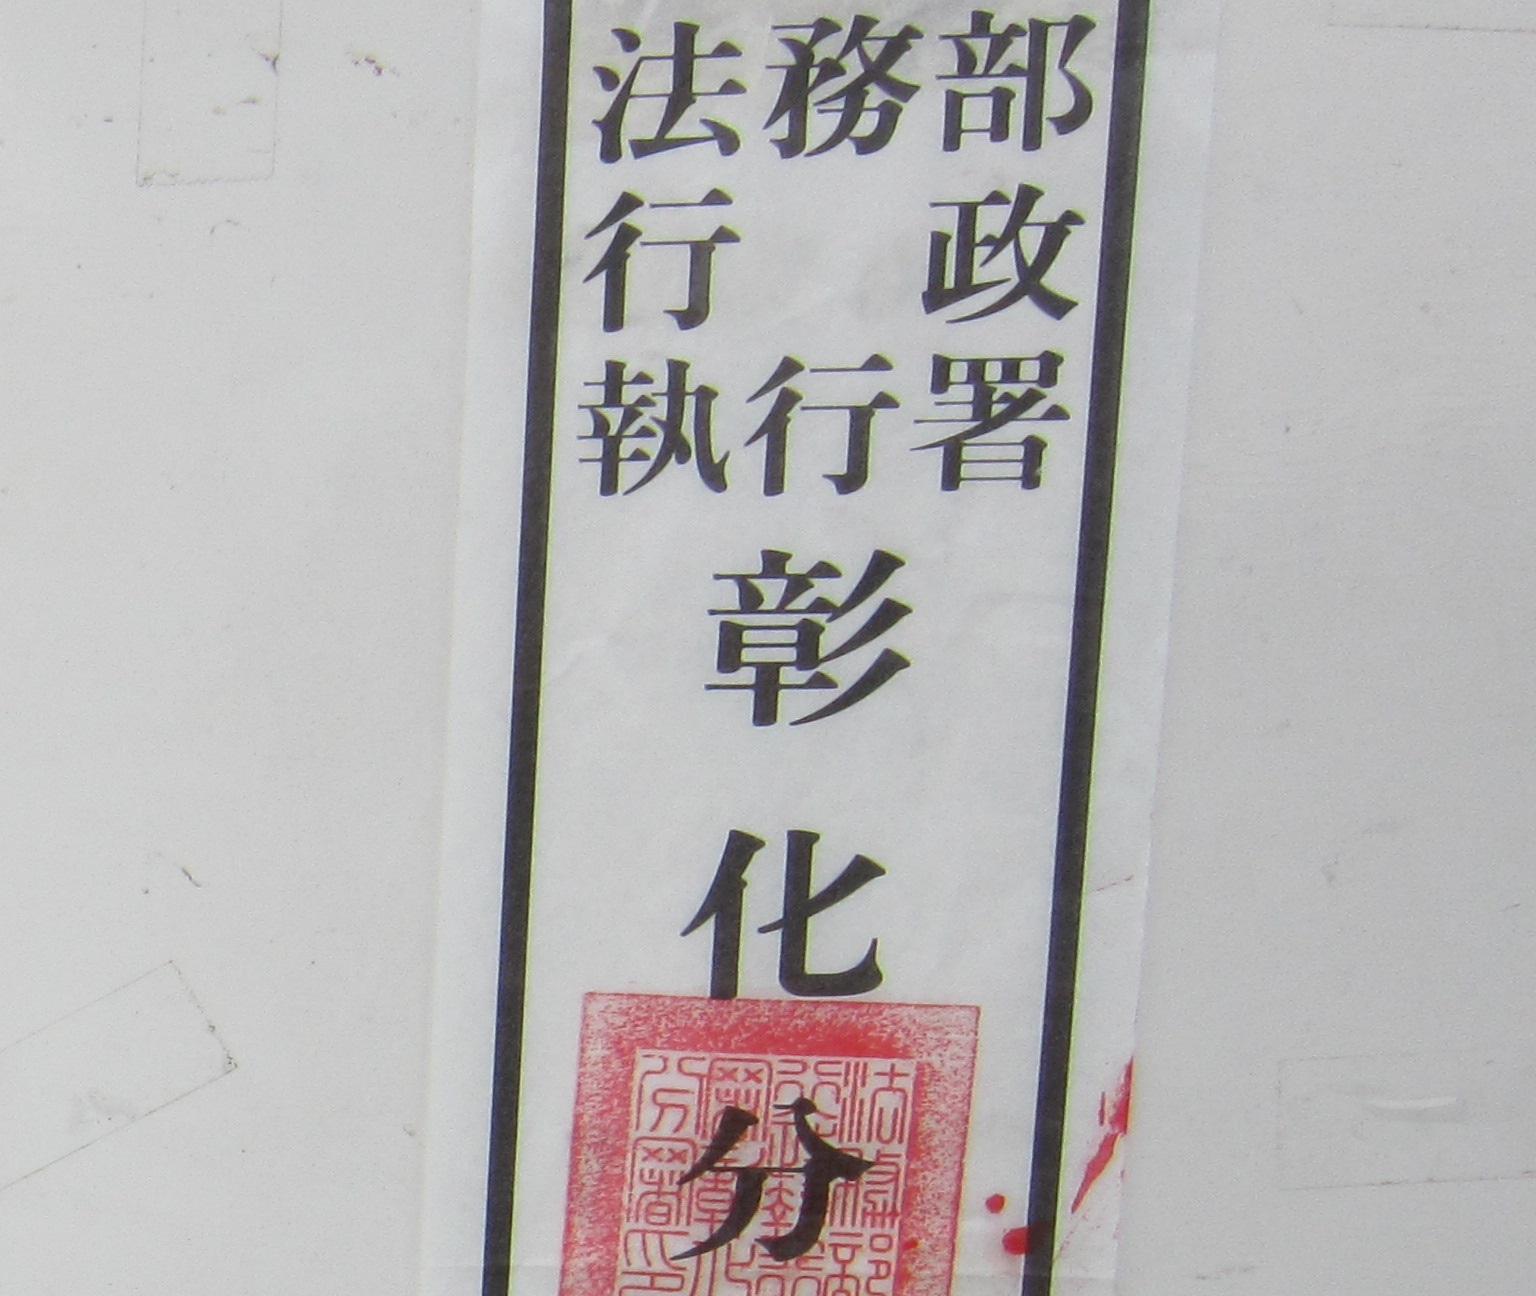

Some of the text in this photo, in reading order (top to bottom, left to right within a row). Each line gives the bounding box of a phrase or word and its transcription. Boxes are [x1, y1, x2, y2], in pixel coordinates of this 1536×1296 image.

[591, 10, 1096, 164] 法務部
[577, 351, 1070, 497] 執行署
